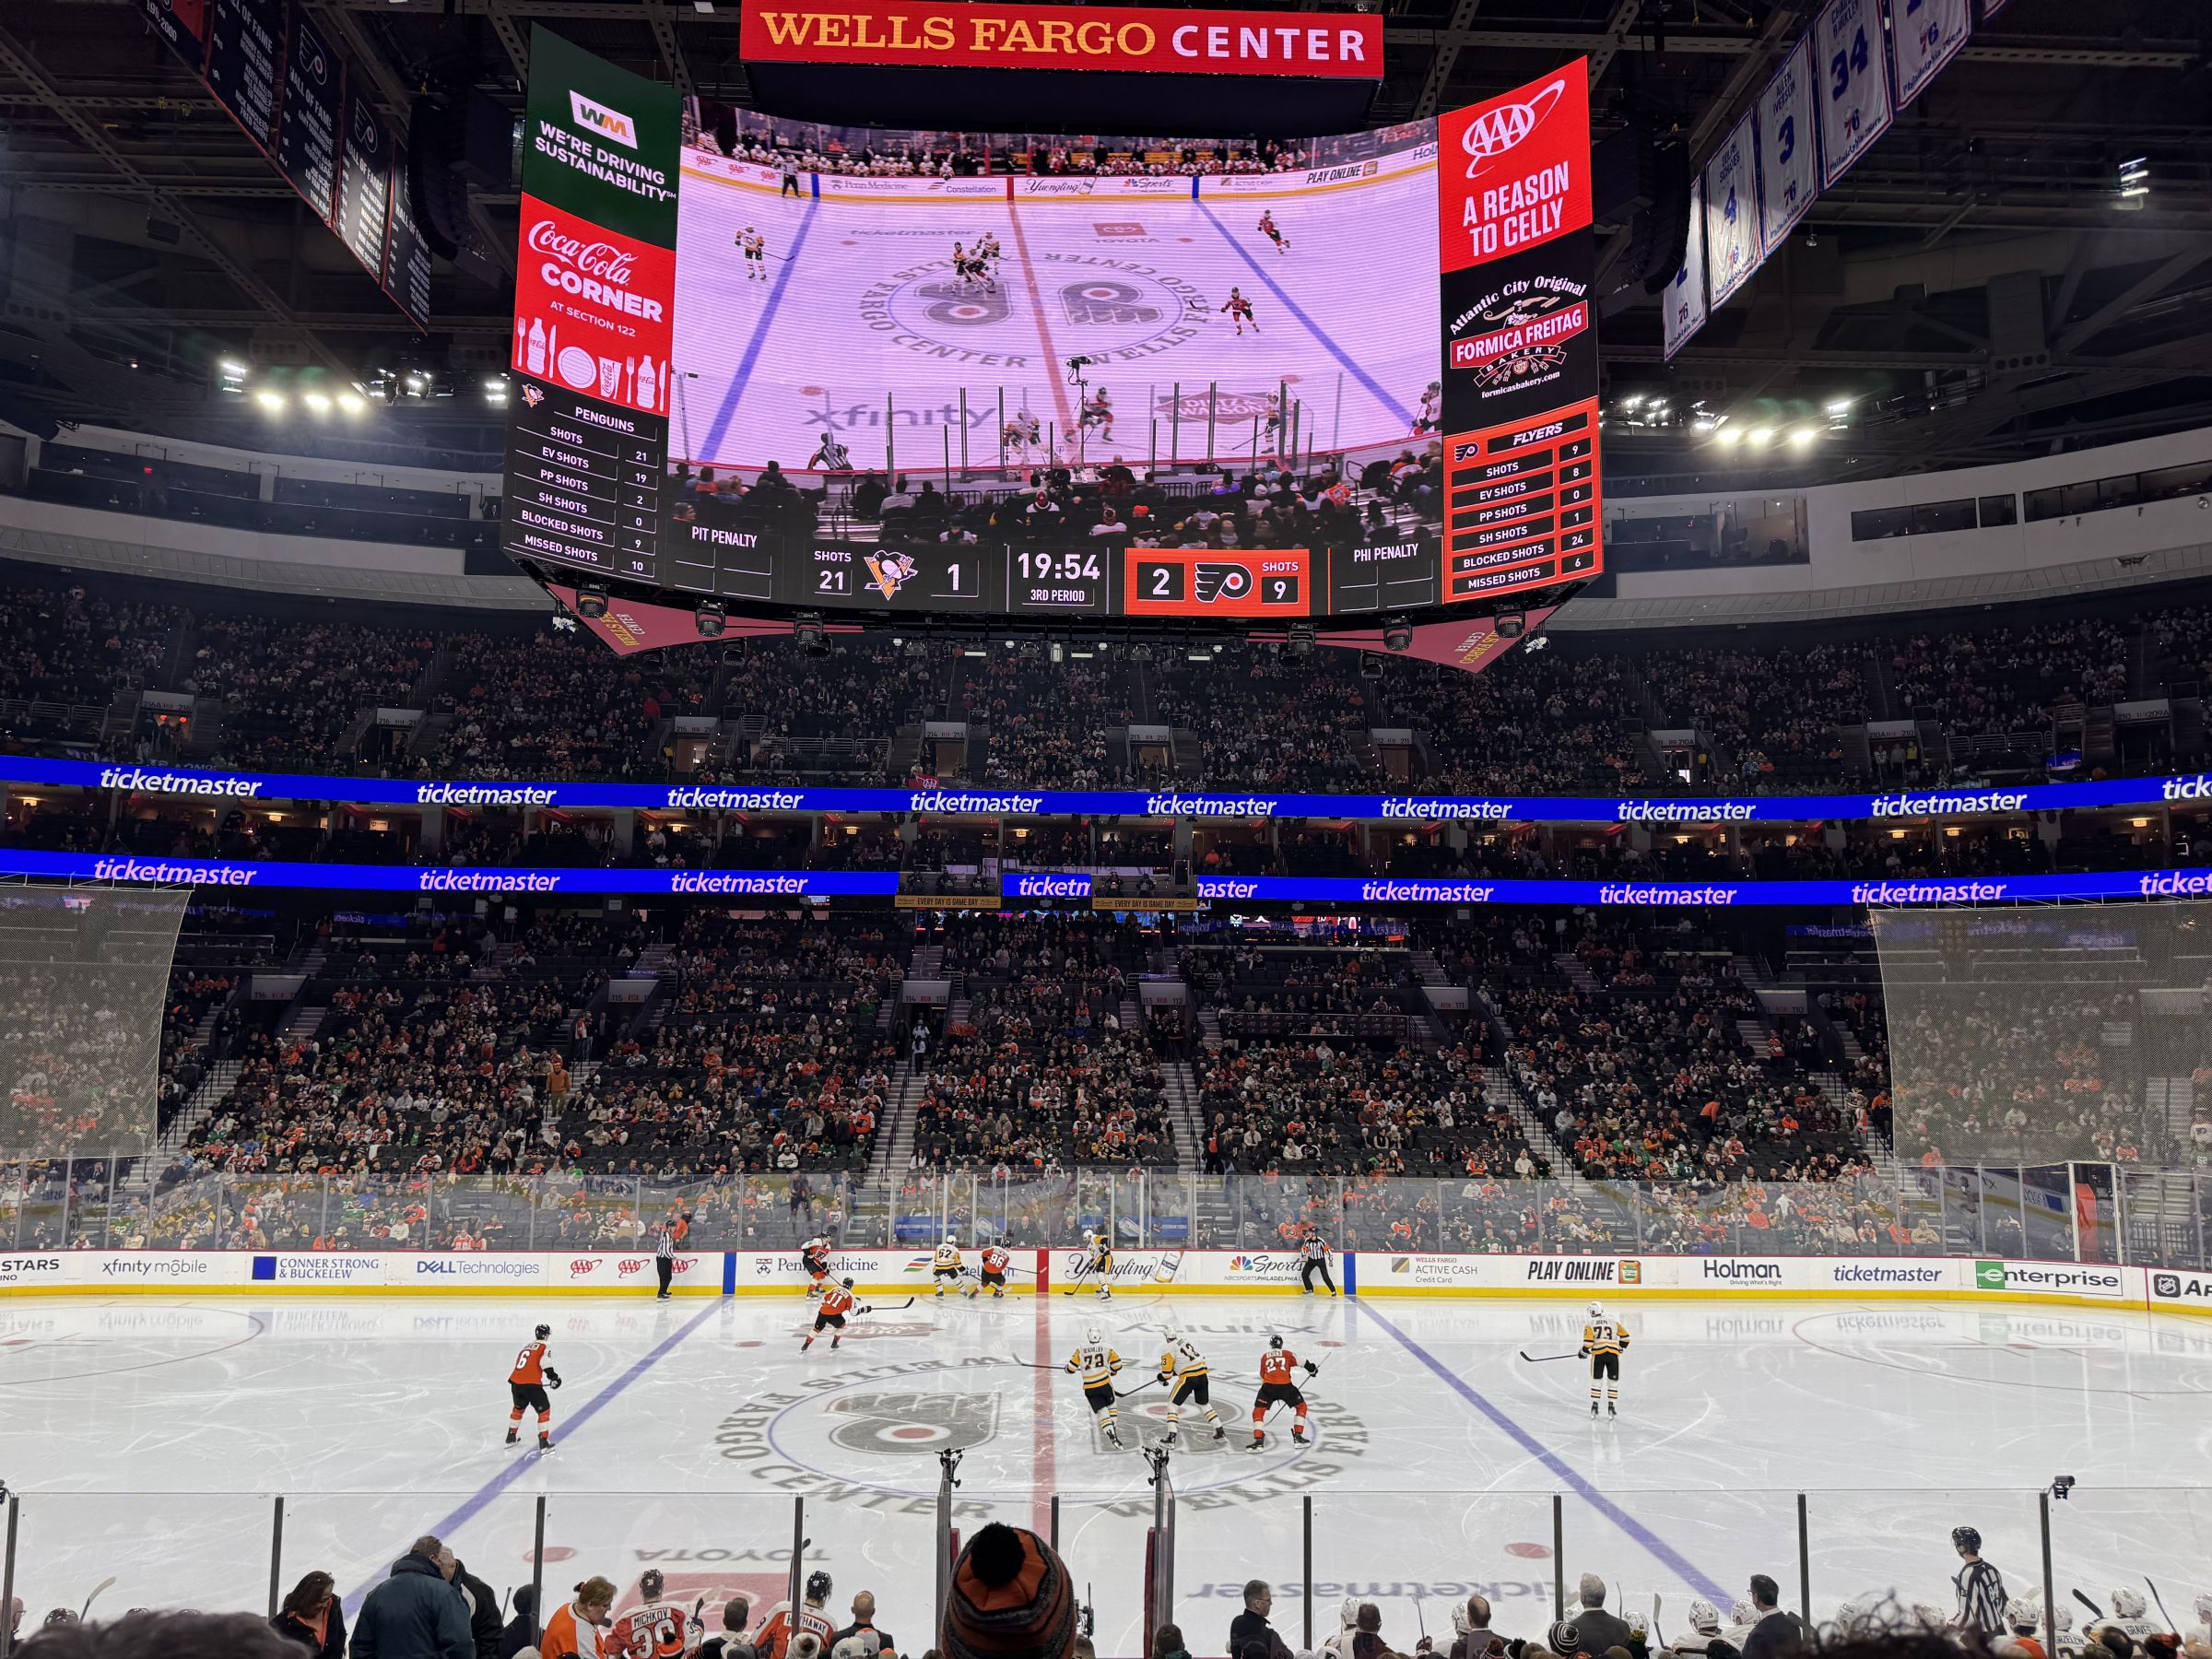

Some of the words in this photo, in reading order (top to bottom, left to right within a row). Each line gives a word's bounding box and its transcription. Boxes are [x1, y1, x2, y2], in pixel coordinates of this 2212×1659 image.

[759, 12, 956, 50] WELLS
[969, 18, 1156, 55] FARGO
[1171, 24, 1367, 61] CENTER
[1830, 24, 1868, 101] 34
[580, 103, 629, 137] WM
[1467, 105, 1530, 156] AAA
[1778, 114, 1794, 165] 3
[540, 120, 593, 157] WE'RE
[597, 147, 665, 185] DRIVING
[1307, 171, 1328, 184] PLAY
[1329, 165, 1362, 181] ONLINE
[946, 184, 996, 194] Constellation
[1463, 195, 1478, 227] A
[1483, 160, 1570, 221] REASON
[1724, 185, 1736, 226] 4
[851, 229, 975, 237] ticketmaster
[1469, 222, 1497, 257] TO
[1503, 196, 1564, 247] CELLY
[528, 220, 639, 285] Coca-Cola
[541, 263, 663, 323] CORNER
[1449, 292, 1500, 335] Atlantic
[1502, 280, 1531, 298] City
[1534, 276, 1587, 297] Original
[550, 300, 565, 313] AT
[566, 307, 615, 331] SECTION
[617, 324, 636, 337] 122
[1456, 329, 1524, 362] FORMICA
[1525, 309, 1583, 344] FREITAG
[892, 333, 1029, 369] CENTER
[1486, 347, 1556, 372] BAKERY
[1481, 371, 1560, 399] formicasbakery.com
[575, 406, 635, 432] PENGUINS
[803, 404, 997, 430] xfinity
[550, 427, 583, 444] SHOTS
[1512, 422, 1563, 446] FLYERS
[542, 446, 555, 458] EV
[557, 450, 589, 469] SHOTS
[635, 451, 647, 461] 21
[1486, 462, 1519, 477] SHOTS
[1571, 445, 1579, 455] 9
[540, 468, 554, 480] PP
[555, 474, 589, 491] SHOTS
[635, 472, 647, 483] 19
[1479, 489, 1493, 500] EV
[1494, 482, 1526, 498] SHOTS
[1572, 467, 1580, 477] 8
[538, 492, 552, 504] SH
[555, 496, 587, 513] SHOTS
[636, 496, 643, 504] 2
[1479, 511, 1493, 523] PP
[1495, 503, 1527, 521] SHOTS
[1572, 489, 1580, 500] 0
[522, 510, 568, 531] BLOCKED
[570, 524, 604, 540] SHOTS
[635, 517, 642, 526] 0
[1479, 533, 1493, 544] SH
[1495, 525, 1528, 542] SHOTS
[1574, 512, 1580, 522] 1
[524, 534, 562, 553] MISSED
[564, 545, 598, 561] SHOTS
[635, 539, 641, 548] 9
[692, 526, 710, 541] PIT
[712, 529, 758, 548] PENALTY
[814, 550, 852, 562] SHOTS
[1354, 548, 1373, 562] PHI
[1374, 543, 1419, 561] PENALTY
[1464, 552, 1510, 569] BLOCKED
[1512, 544, 1545, 559] SHOTS
[1571, 535, 1583, 546] 24
[631, 560, 643, 571] 10
[1017, 552, 1100, 581] 19:54
[1262, 561, 1299, 572] SHOTS
[1468, 571, 1506, 590] MISSED
[1508, 568, 1540, 582] SHOTS
[1574, 558, 1581, 568] 6
[819, 571, 844, 591] 21
[947, 563, 960, 591] 1
[1152, 569, 1170, 595] 2
[1030, 589, 1050, 602] 3RD
[1052, 589, 1085, 602] PERIOD
[1274, 581, 1287, 600] 9
[100, 768, 263, 797] ticketmaster
[417, 783, 557, 806] ticketmaster
[666, 787, 805, 810] ticketmaster
[910, 792, 1042, 813] ticketmaster
[1871, 792, 2027, 818] ticketmaster
[1147, 795, 1277, 817] ticketmaster
[1381, 798, 1512, 819] ticketmaster
[1618, 801, 1756, 821] ticketmaster
[94, 859, 257, 887] ticketmaster
[419, 870, 559, 892] ticketmaster
[670, 872, 808, 895] ticketmaster
[917, 898, 933, 906] EVERY
[935, 898, 945, 906] DAY
[952, 898, 967, 906] GAME
[1361, 881, 1494, 903] ticketmaster
[1599, 884, 1737, 905] ticketmaster
[1852, 881, 2006, 903] ticketmaster
[1115, 900, 1131, 908] EVERY
[1132, 900, 1142, 908] DAY
[1149, 900, 1164, 908] GAME
[1165, 900, 1175, 908] DAY
[1, 1259, 60, 1271] STARS
[102, 1260, 152, 1276] xfinity
[155, 1259, 207, 1276] mobile
[280, 1258, 329, 1269] CONNER
[331, 1258, 379, 1270] STRONG
[417, 1260, 456, 1274] DELL
[456, 1260, 540, 1277] Technologies
[571, 1260, 593, 1273] AAA
[618, 1260, 641, 1273] AAA
[830, 1257, 878, 1271] edicine
[989, 1253, 1005, 1268] 96
[1253, 1255, 1304, 1274] Sports
[1416, 1265, 1451, 1275] ACTIVE
[1452, 1265, 1478, 1275] CASH
[1527, 1261, 1563, 1280] PLAY
[1564, 1261, 1615, 1281] ONLINE
[1703, 1259, 1782, 1278] Holman
[279, 1269, 288, 1279] &
[288, 1269, 352, 1279] BUCKELEW
[1832, 1265, 1943, 1282] ticketmaster
[1983, 1266, 2119, 1288] enterprise
[827, 1292, 843, 1308] 11
[1594, 1326, 1612, 1340] 73
[516, 1350, 530, 1370] 6
[1084, 1353, 1104, 1371] 72
[1181, 1343, 1200, 1361] 13
[800, 1356, 1012, 1390] WELLS
[1265, 1357, 1287, 1372] 27
[714, 1392, 807, 1460] FARGO
[751, 1465, 996, 1518] CENTER
[633, 1548, 831, 1561] TOYOTA
[633, 1610, 668, 1628] MICHKOV
[786, 1613, 828, 1634] HHAWAY
[2127, 1625, 2151, 1635] GRAVES
